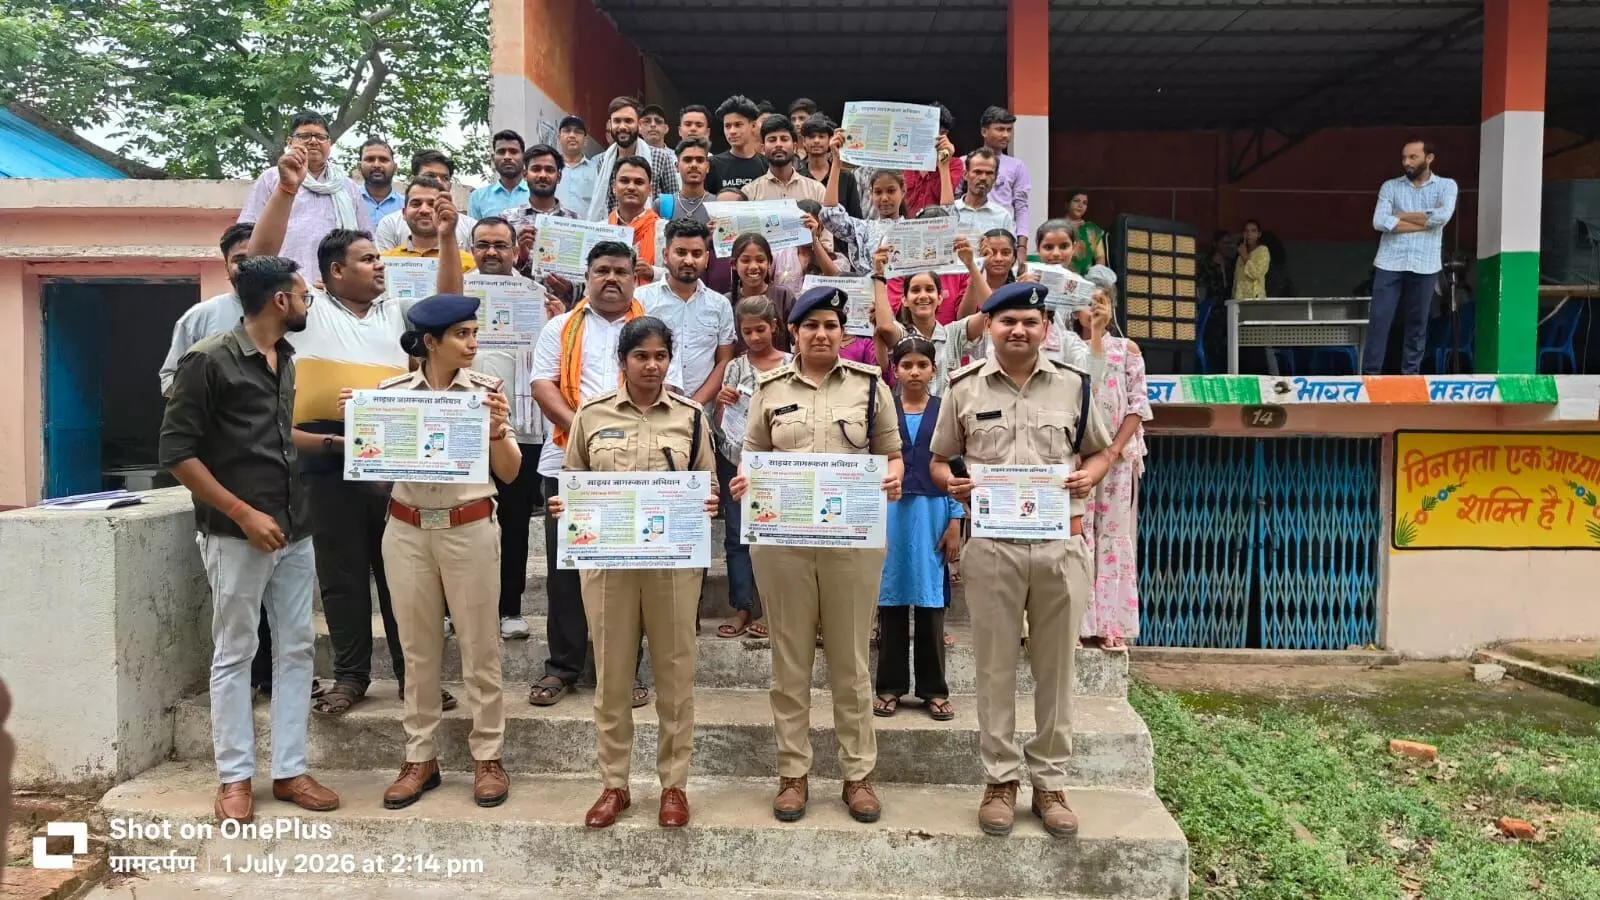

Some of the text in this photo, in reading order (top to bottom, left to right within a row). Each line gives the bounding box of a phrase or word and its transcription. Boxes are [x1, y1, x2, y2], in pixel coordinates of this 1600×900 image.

[1293, 377, 1365, 402] भारत
[1429, 380, 1498, 401] महान
[1252, 410, 1273, 425] 14
[1402, 445, 1500, 492] विनम्रता
[1504, 445, 1542, 475] एक
[1456, 486, 1533, 526] शक्ति
